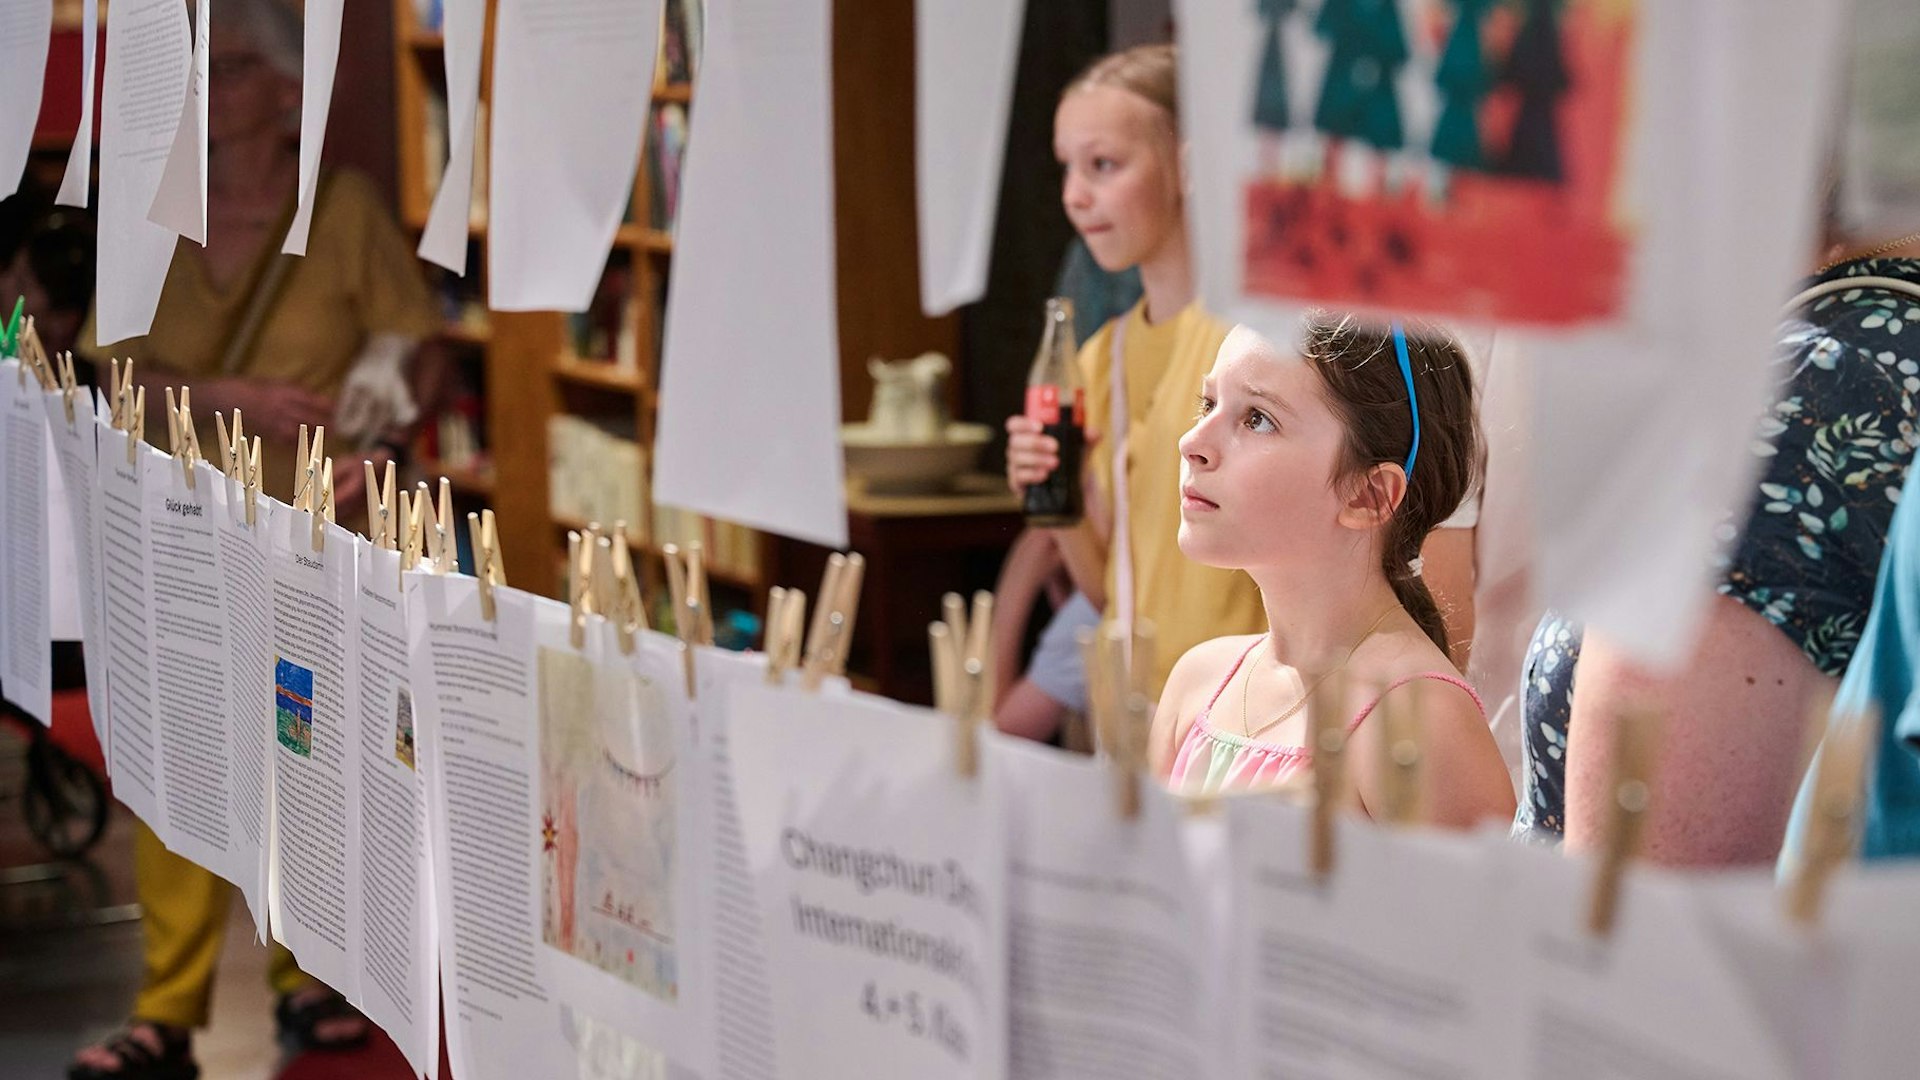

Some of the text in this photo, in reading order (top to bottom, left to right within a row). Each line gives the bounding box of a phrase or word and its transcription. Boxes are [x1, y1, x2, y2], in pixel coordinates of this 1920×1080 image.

[166, 498, 181, 512] Glück
[295, 553, 303, 565] Der
[782, 828, 937, 897] Changchun
